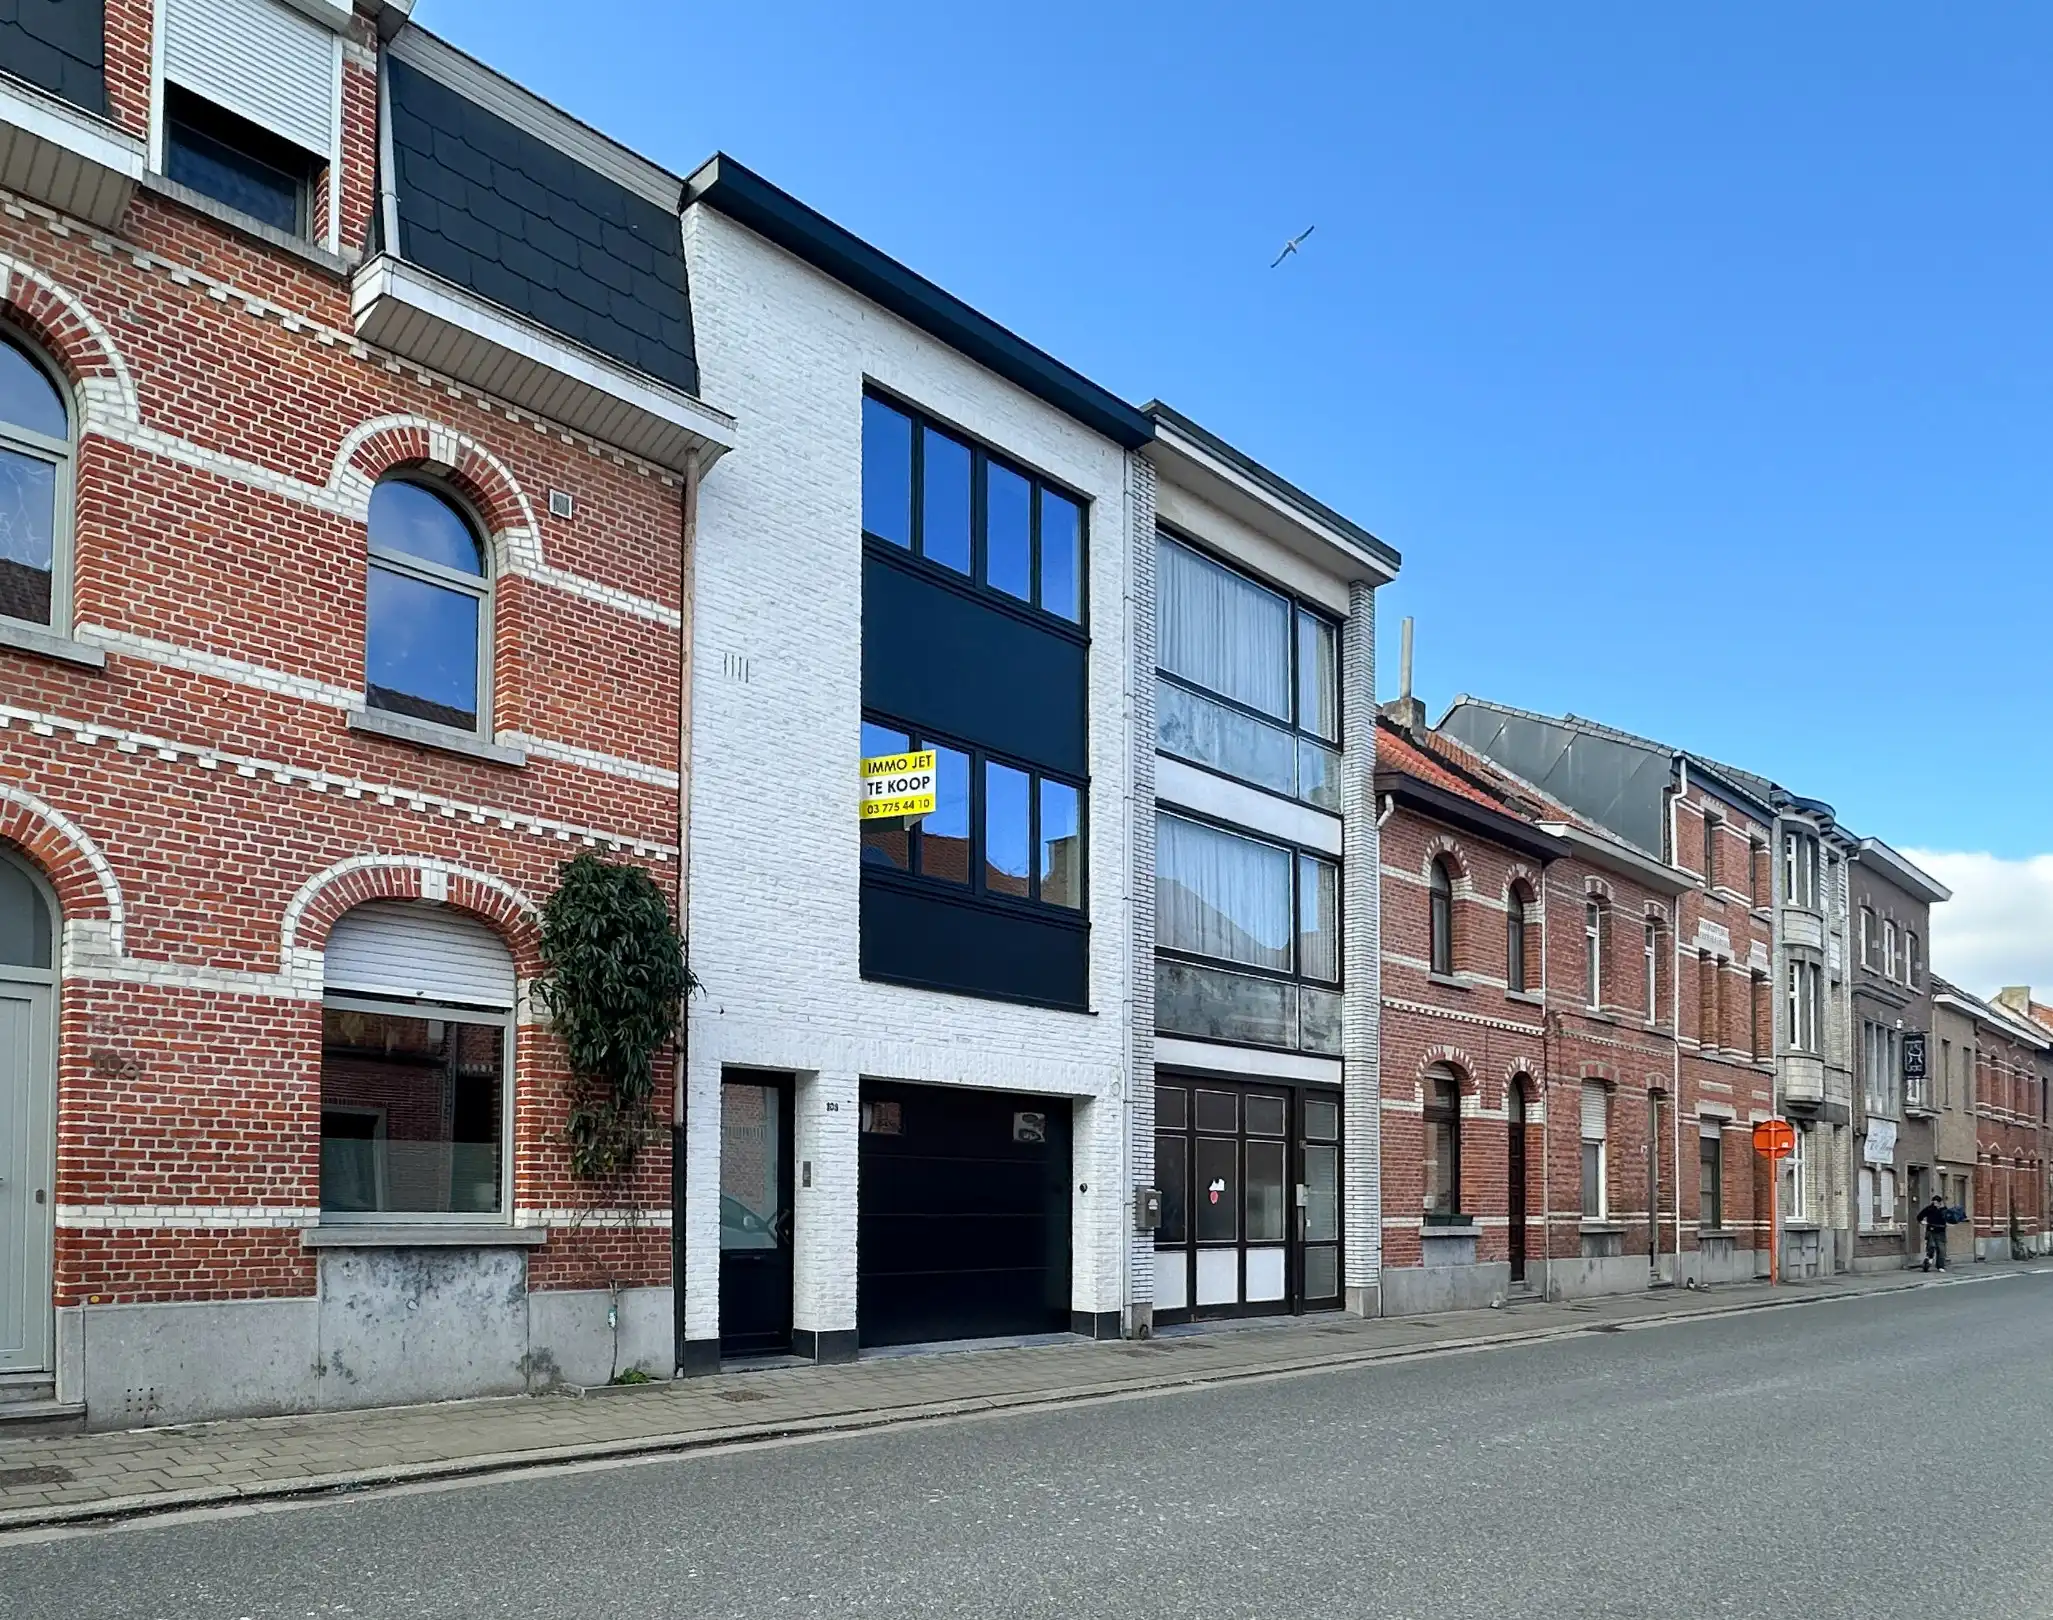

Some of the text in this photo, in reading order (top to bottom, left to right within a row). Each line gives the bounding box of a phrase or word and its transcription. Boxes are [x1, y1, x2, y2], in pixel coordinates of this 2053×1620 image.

[868, 755, 932, 774] IMMO JET
[867, 776, 930, 795] TE KOOP
[867, 799, 930, 814] 03 775 44 10
[90, 1053, 140, 1078] 106
